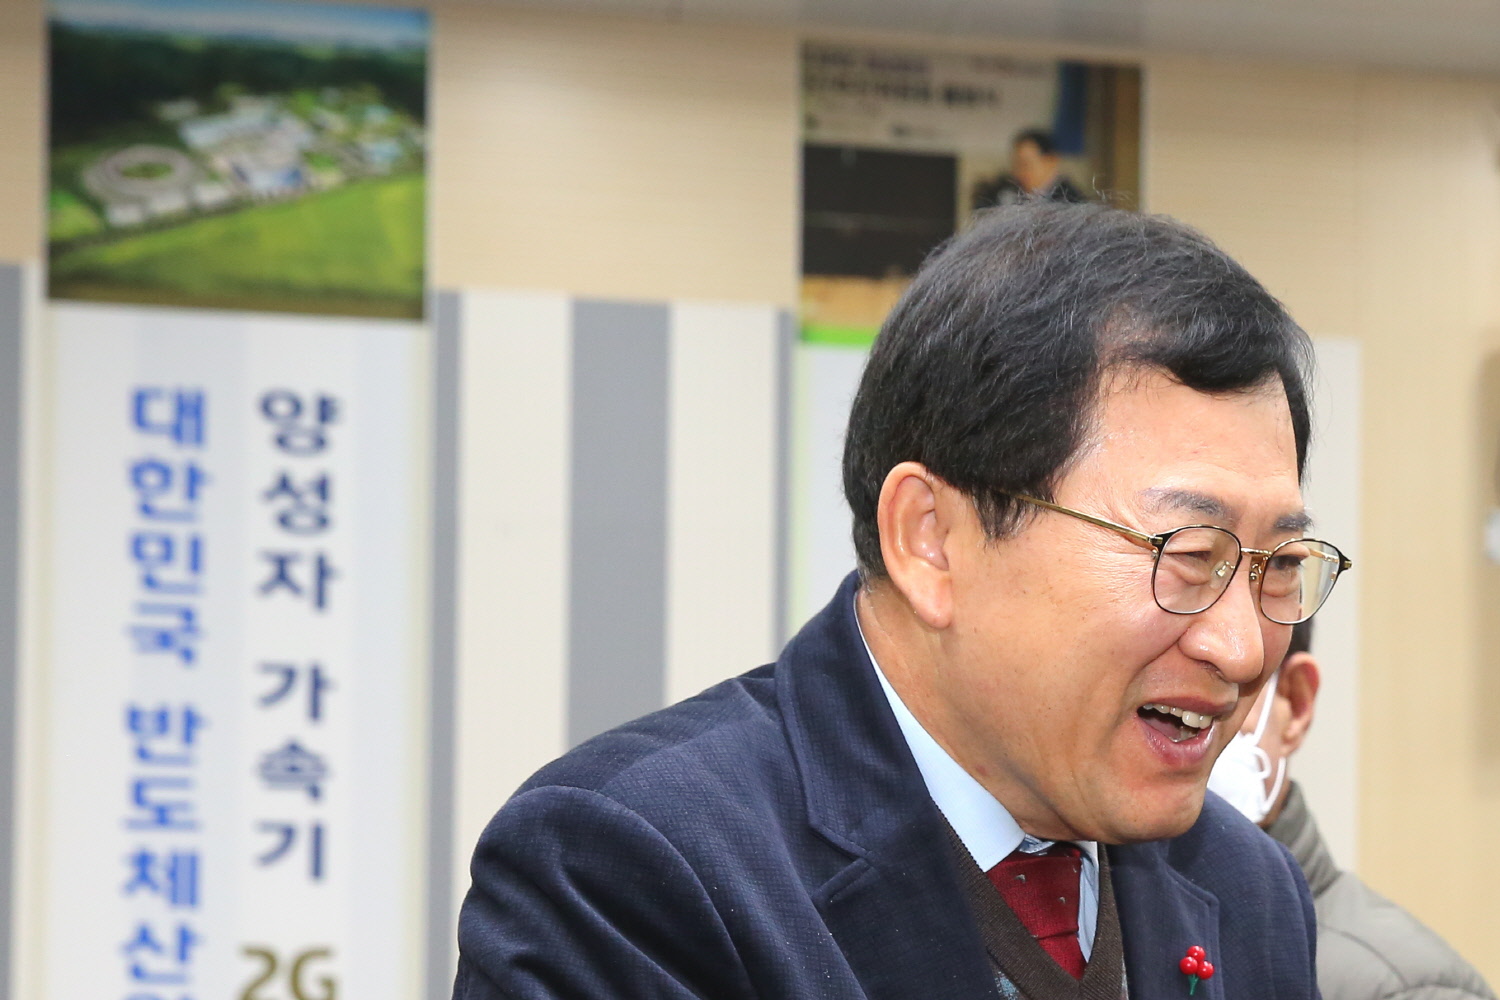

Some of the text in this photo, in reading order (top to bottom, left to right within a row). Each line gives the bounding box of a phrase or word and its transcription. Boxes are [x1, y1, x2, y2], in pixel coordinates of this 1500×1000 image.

[128, 387, 211, 667] 대한민국
[255, 389, 341, 881] 양성자 가속기
